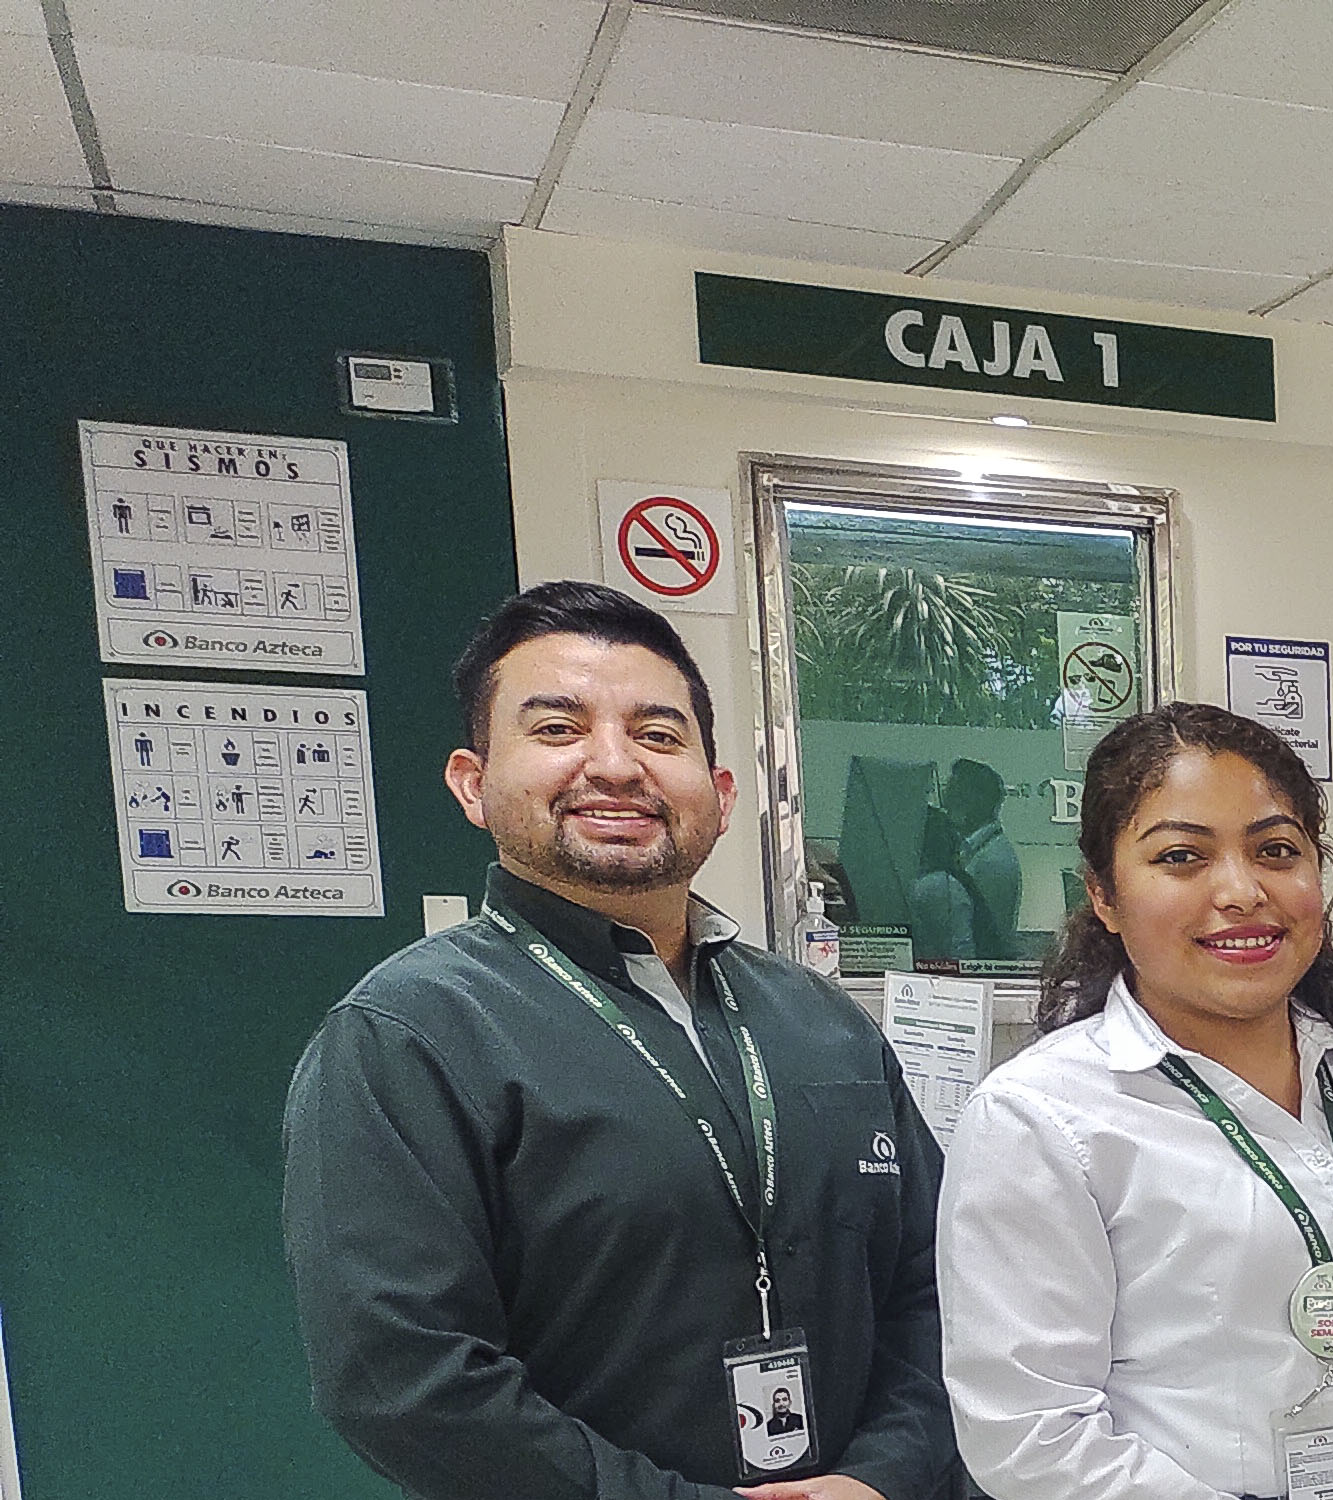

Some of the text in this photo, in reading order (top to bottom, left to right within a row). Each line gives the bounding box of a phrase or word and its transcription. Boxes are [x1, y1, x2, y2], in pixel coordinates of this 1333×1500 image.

[885, 309, 1119, 388] CAJA 1
[142, 438, 247, 458] QUE HACER
[133, 450, 301, 480] SISMOS
[184, 635, 324, 657] Banco Azteca
[1230, 641, 1253, 653] POR
[1268, 643, 1325, 657] SEGURIDAD
[121, 702, 357, 726] INCENDIOS
[206, 883, 344, 901] Banco Azteca
[542, 956, 603, 1008] Banco Azteca
[631, 1038, 687, 1099] Banco Azteca
[1180, 1073, 1210, 1104] Azteca
[763, 1118, 776, 1189] Banco Azteca
[1232, 1133, 1284, 1191] Banco Azteca
[1303, 1226, 1322, 1259] Banco
